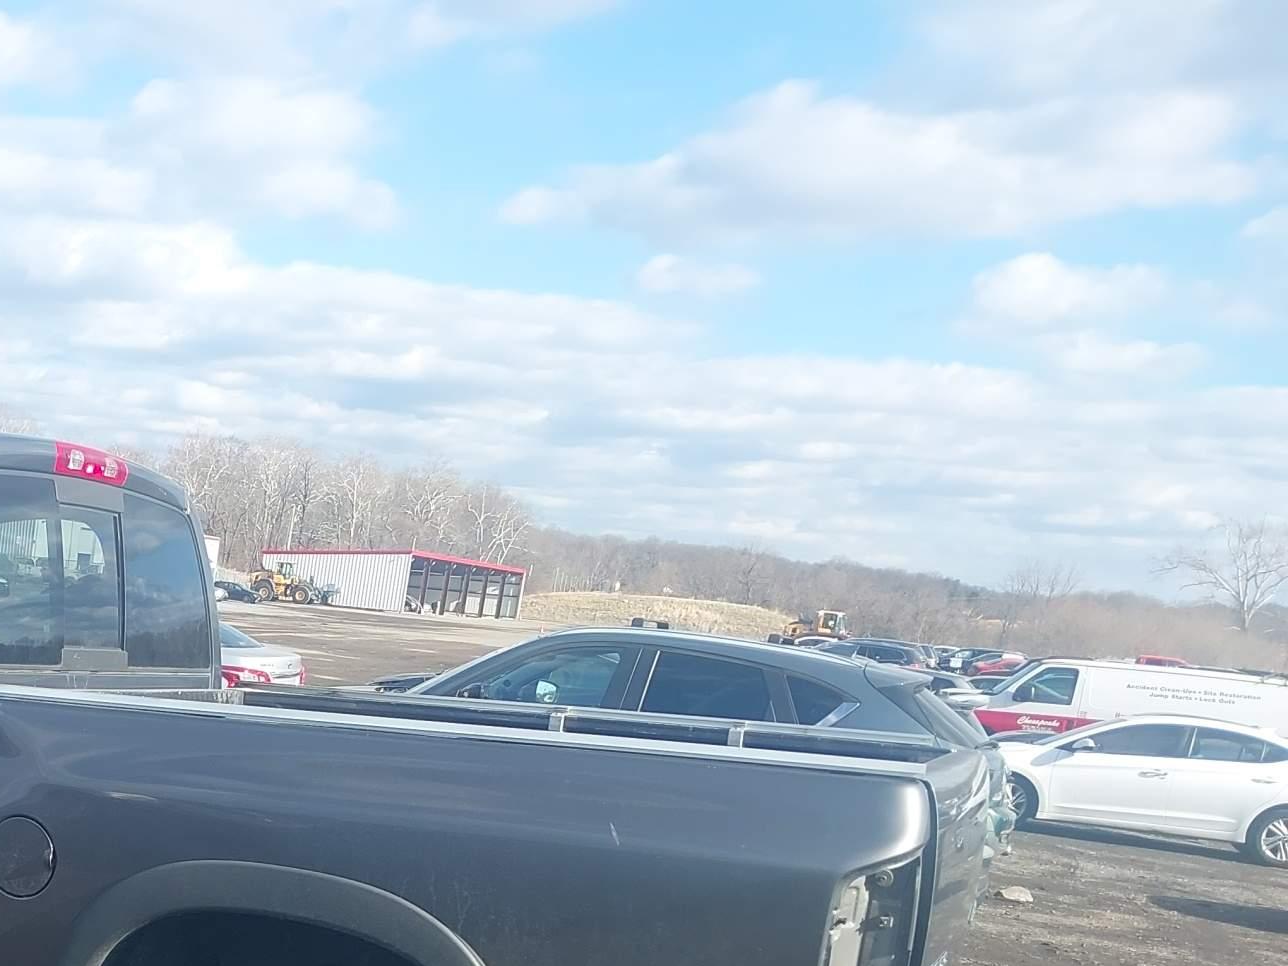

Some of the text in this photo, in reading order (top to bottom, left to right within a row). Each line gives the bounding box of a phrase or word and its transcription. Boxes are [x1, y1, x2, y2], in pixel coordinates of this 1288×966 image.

[1126, 683, 1158, 691] Accident
[1219, 691, 1262, 700] Restoration
[1149, 692, 1169, 700] Jump
[1218, 697, 1235, 705] Outs
